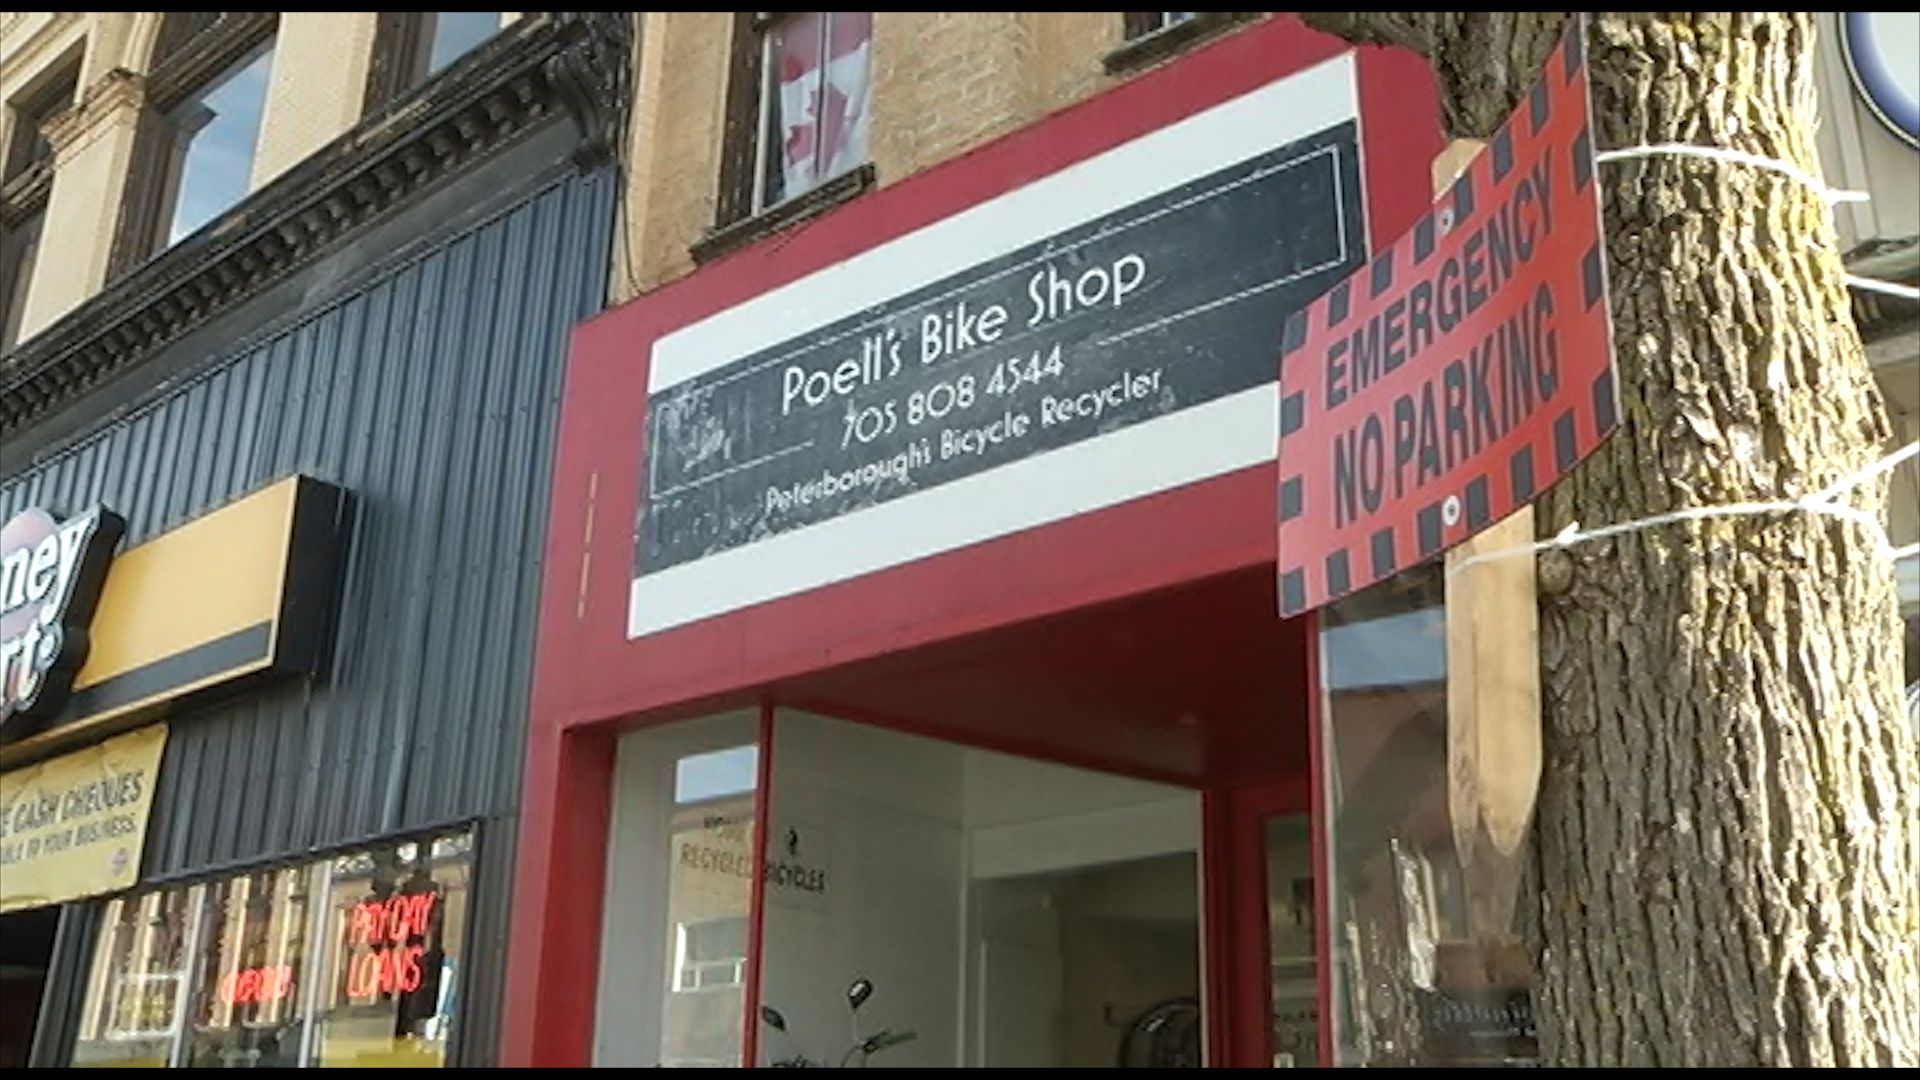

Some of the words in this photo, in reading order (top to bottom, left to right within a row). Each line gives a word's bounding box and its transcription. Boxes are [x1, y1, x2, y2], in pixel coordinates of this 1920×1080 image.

[1326, 145, 1552, 411] EMERGENCY
[782, 327, 901, 416] Poell's
[920, 302, 1008, 364] Bike
[1027, 255, 1145, 328] Shop
[841, 401, 898, 450] 705
[907, 375, 975, 426] 808
[986, 343, 1065, 395] 4544
[940, 412, 1031, 460] Bicycle
[1041, 367, 1162, 428] Recycler
[1334, 412, 1384, 529] NO
[1394, 281, 1558, 499] PARKING
[14, 797, 60, 833] CASH
[62, 770, 143, 820] CHEQUES
[350, 891, 436, 944] PAYDAY
[347, 944, 422, 997] LOANS
